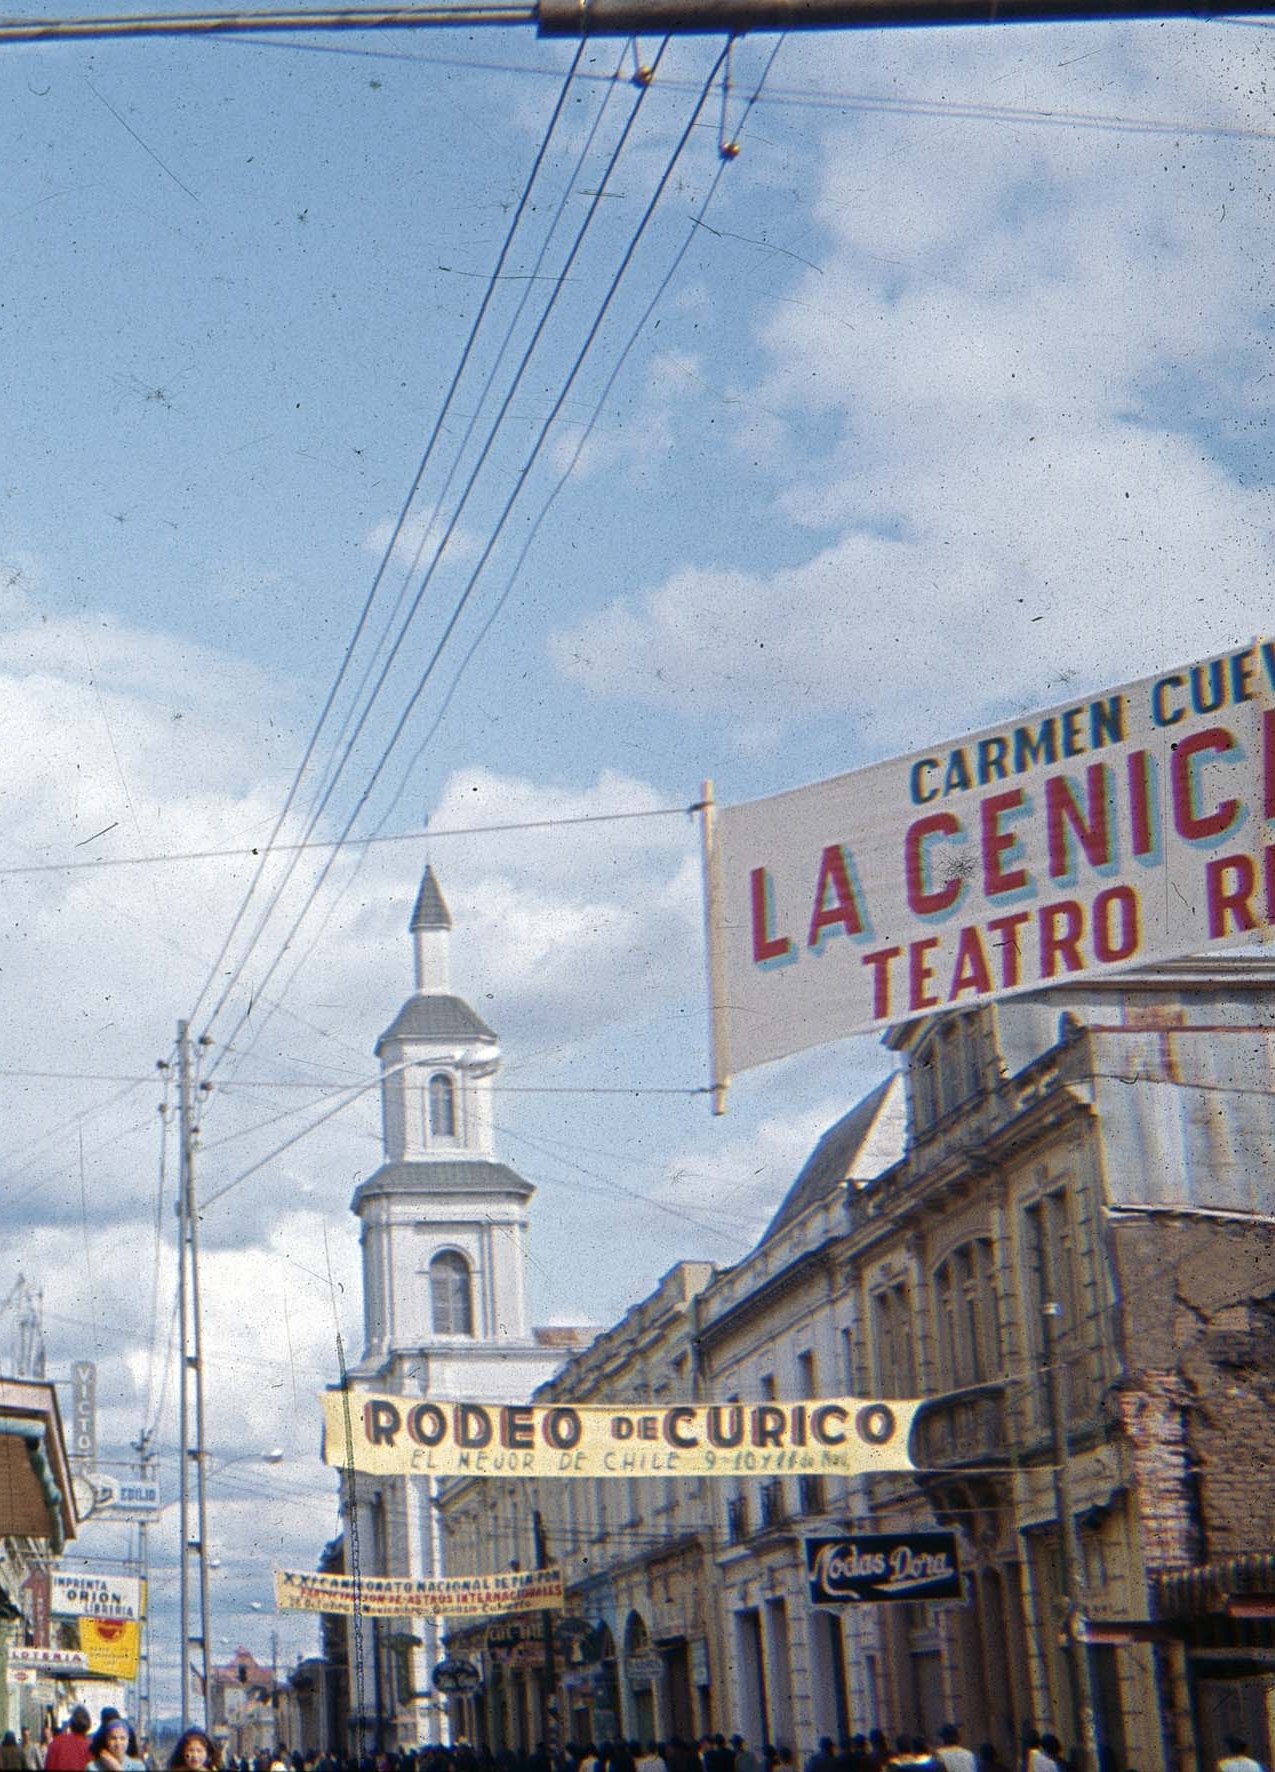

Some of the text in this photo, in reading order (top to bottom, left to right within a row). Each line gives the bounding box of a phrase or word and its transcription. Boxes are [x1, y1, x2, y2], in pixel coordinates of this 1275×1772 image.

[909, 694, 1124, 805] CARMEN
[750, 843, 873, 971] LA
[862, 885, 1143, 1019] TEATRO
[364, 1399, 897, 1451] RODEO DE CURICO
[410, 1449, 437, 1469] EL
[558, 1452, 588, 1471] DE
[603, 1450, 681, 1472] CHILE
[888, 1545, 953, 1582] Dora
[66, 1588, 121, 1604] ORION
[320, 1576, 413, 1592] CAMONATO
[416, 1579, 490, 1592] NACIONAL
[12, 1650, 82, 1663] LOTERIA
